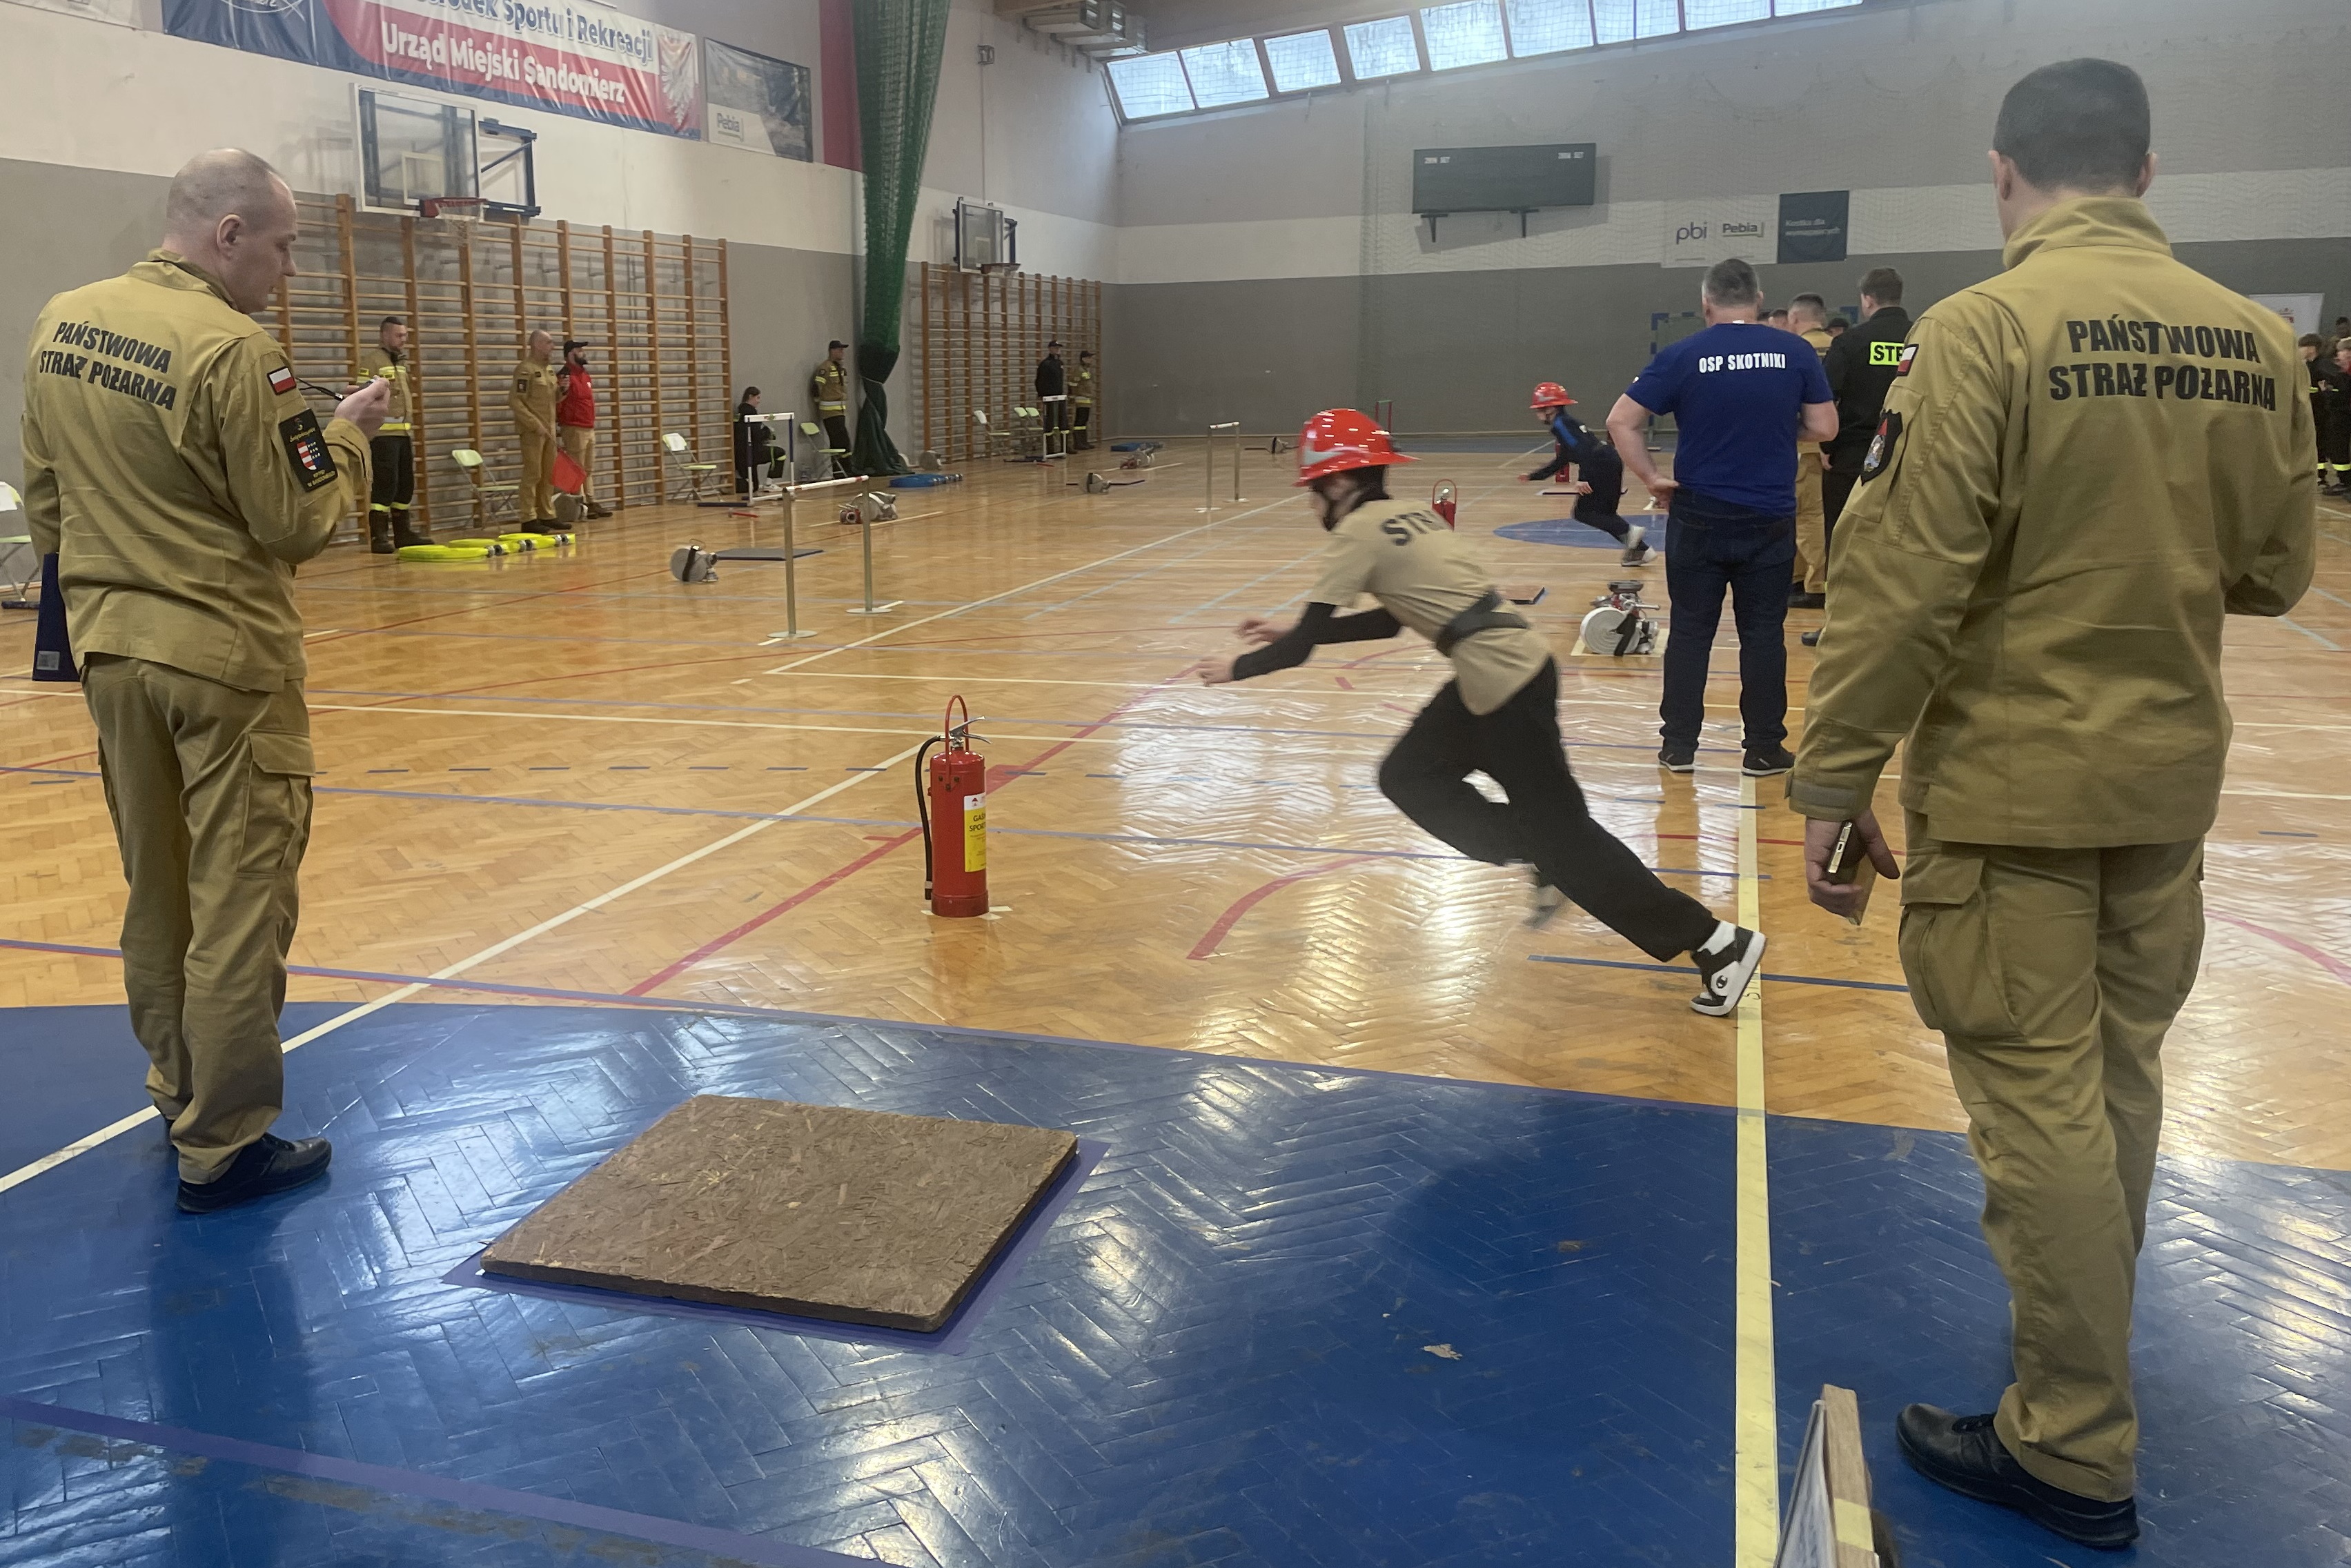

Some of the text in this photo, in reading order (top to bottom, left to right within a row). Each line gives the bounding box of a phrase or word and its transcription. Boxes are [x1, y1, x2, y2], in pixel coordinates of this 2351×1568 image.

[503, 0, 564, 37] Sportu
[567, 8, 573, 39] i
[577, 17, 653, 63] Rekreacji
[382, 21, 625, 103] Urząd Miejski Sandomierz
[1676, 221, 1708, 245] pbi
[1722, 223, 1758, 233] Pebia
[52, 320, 172, 374] PAŃSTWOWA
[1699, 353, 1786, 373] OSP SKOTNIKI
[2066, 313, 2262, 364] PAŃSTWOWA
[39, 350, 177, 410] STRAŻ POŻARNA
[2049, 363, 2276, 412] STRAŻ POŻARNA
